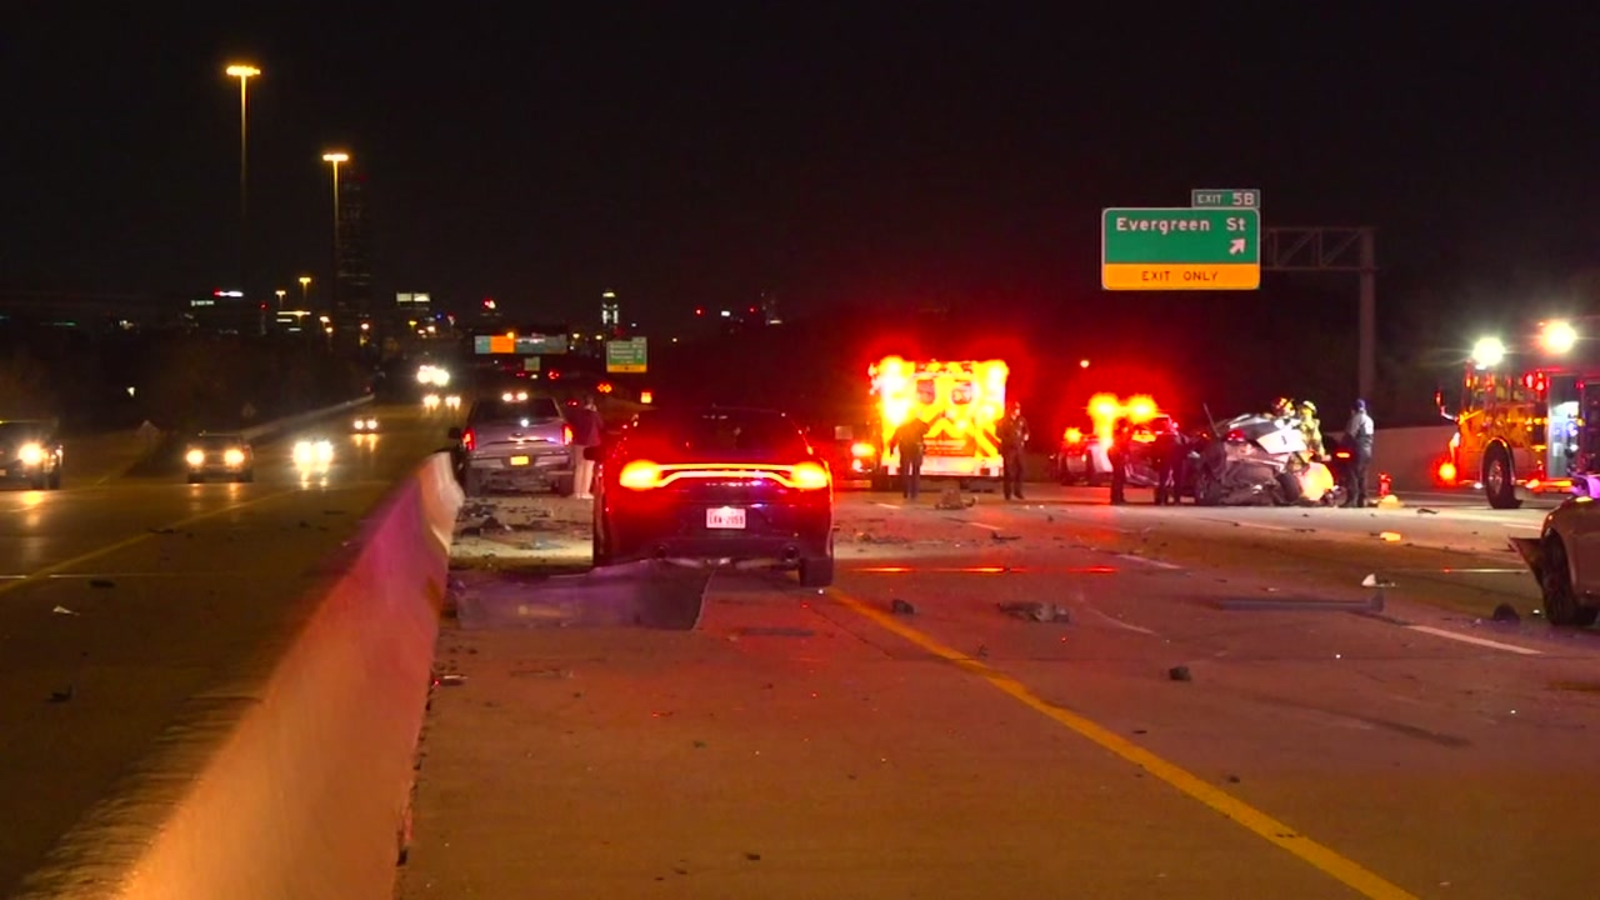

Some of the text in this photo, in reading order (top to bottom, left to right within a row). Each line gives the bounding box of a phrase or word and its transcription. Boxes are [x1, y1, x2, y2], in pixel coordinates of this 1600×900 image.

[1197, 193, 1255, 206] EXIT 5B
[1116, 217, 1246, 235] Evergreen St
[1141, 271, 1218, 281] EXIT ONLY
